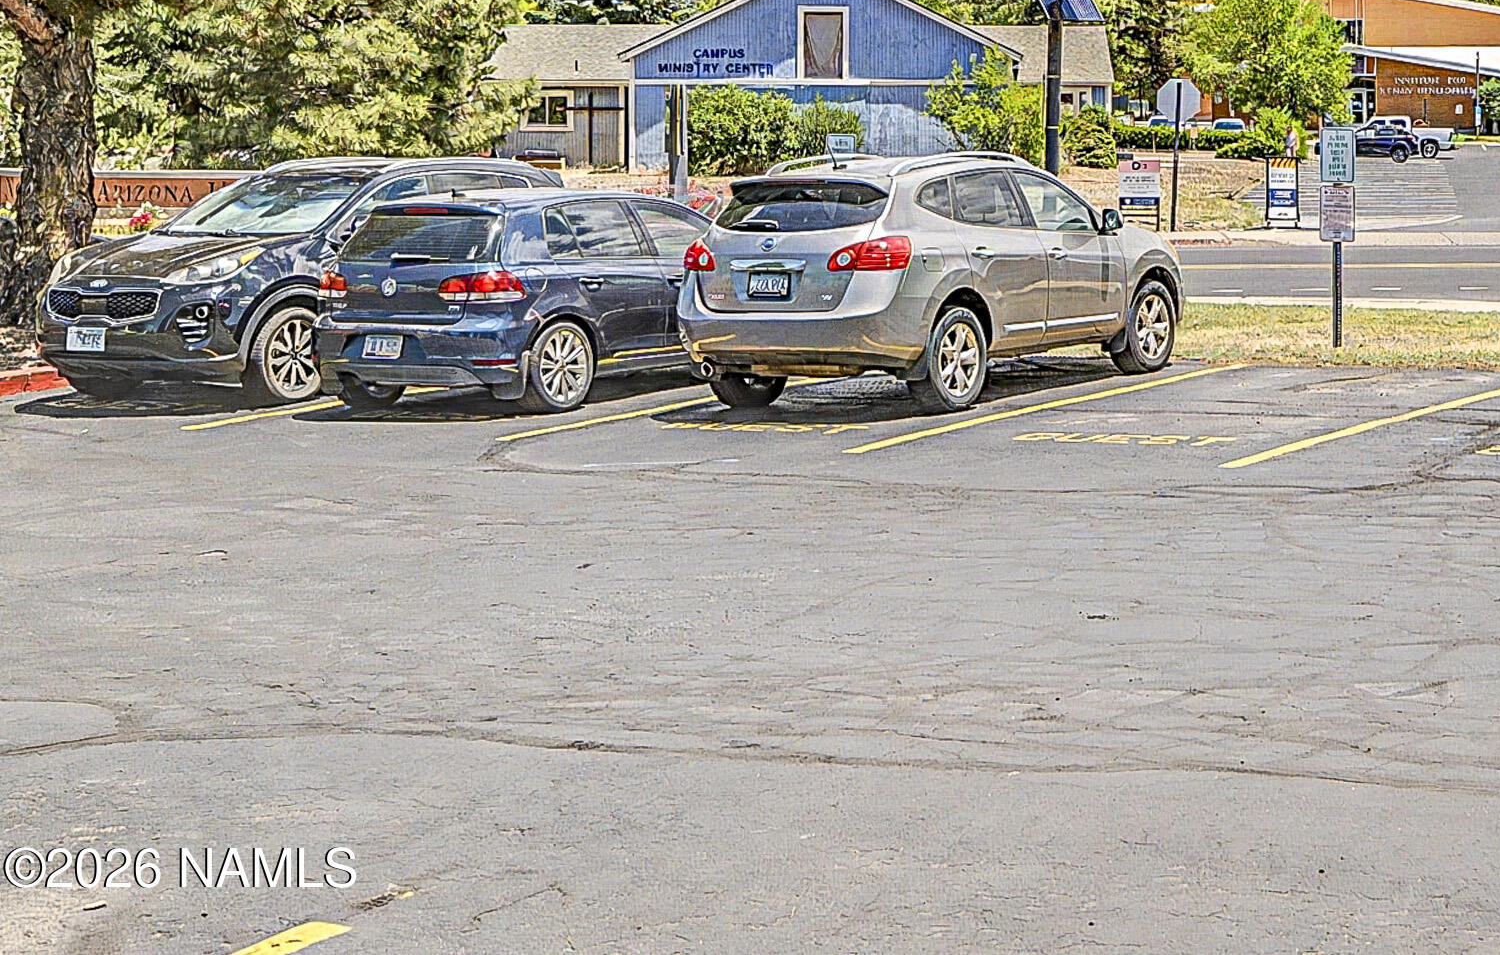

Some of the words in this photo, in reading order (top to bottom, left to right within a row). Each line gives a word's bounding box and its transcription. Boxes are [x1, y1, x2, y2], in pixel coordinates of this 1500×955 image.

[692, 47, 745, 59] CAMPUS
[97, 180, 194, 203] ARIZONA
[1012, 431, 1238, 447] GUEST
